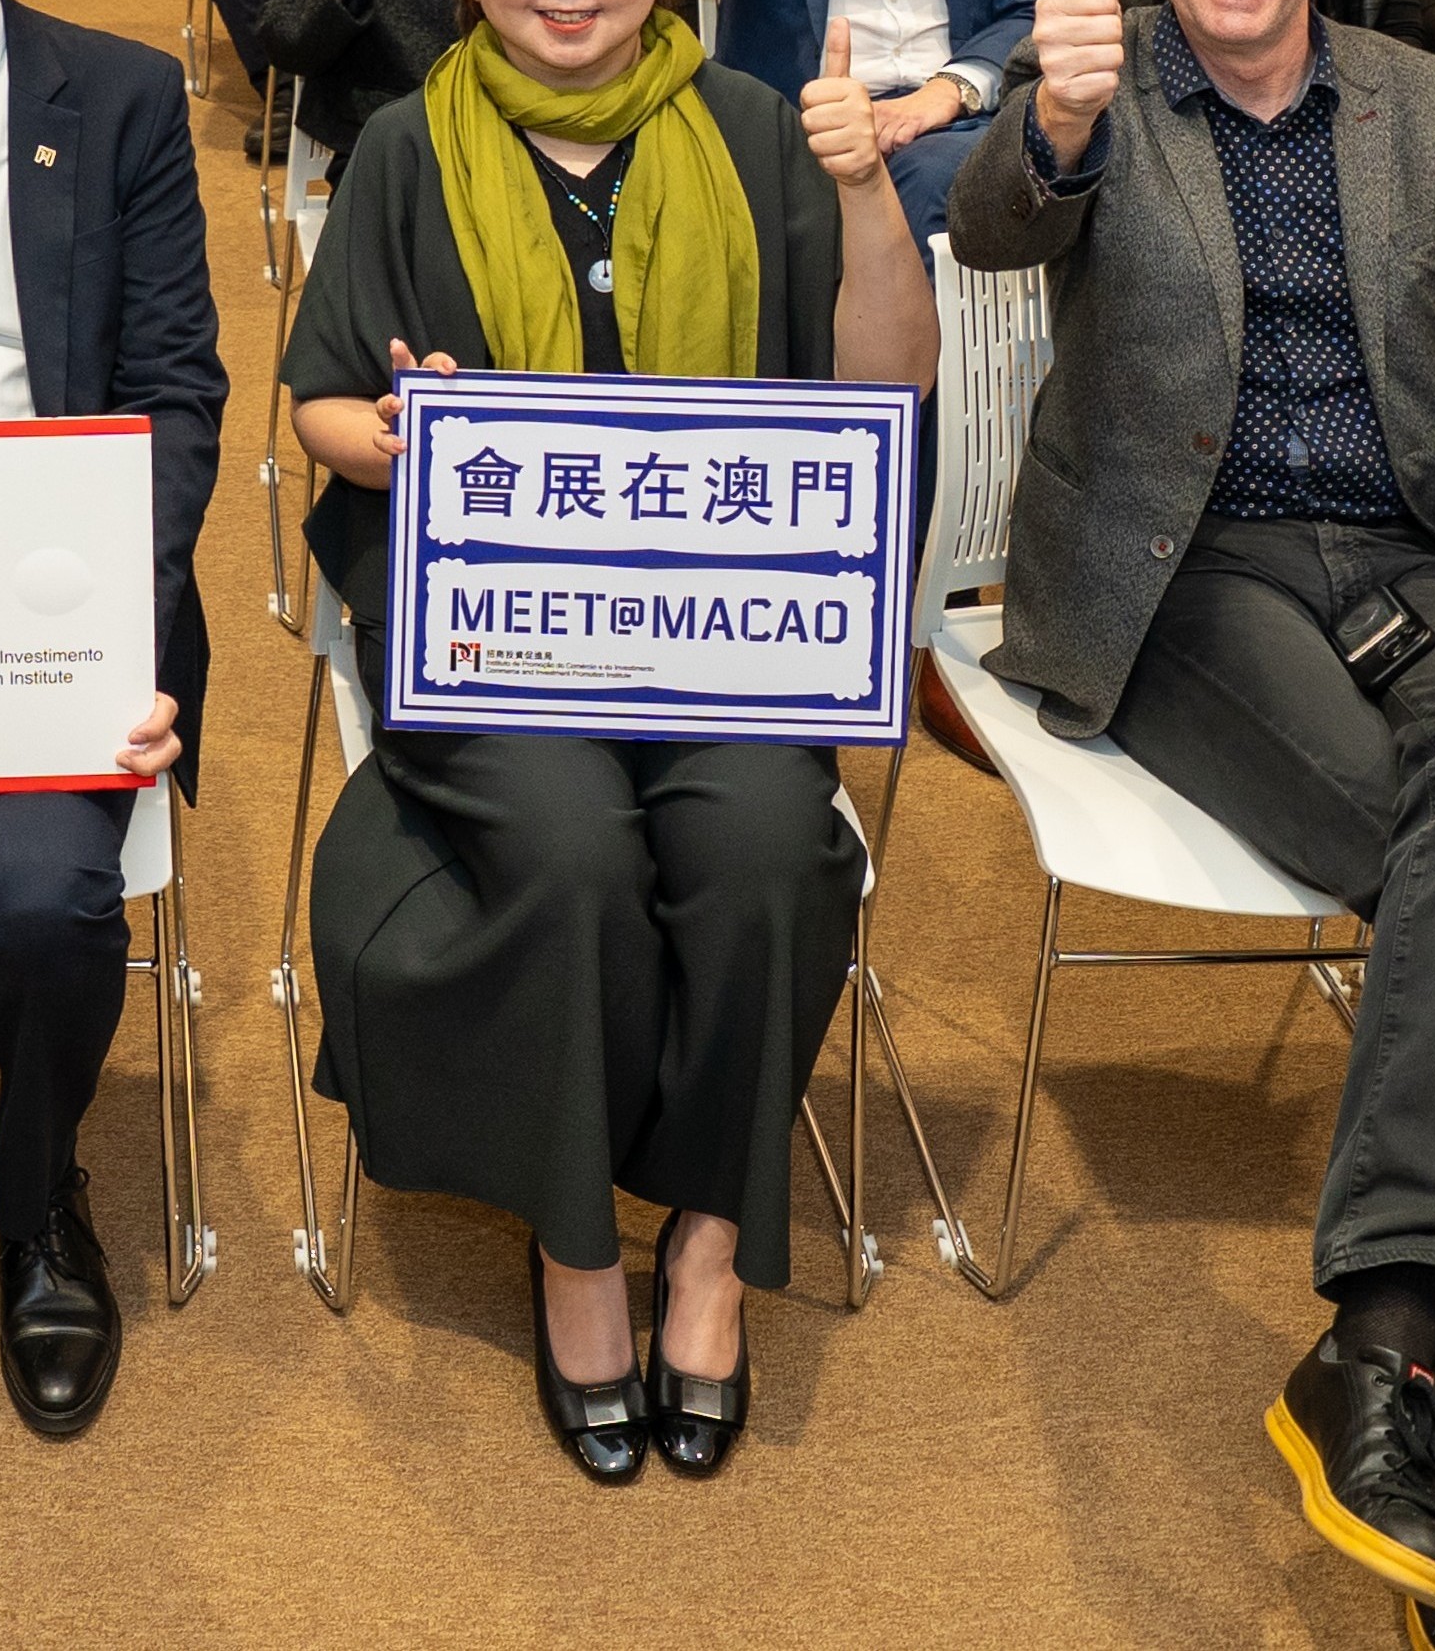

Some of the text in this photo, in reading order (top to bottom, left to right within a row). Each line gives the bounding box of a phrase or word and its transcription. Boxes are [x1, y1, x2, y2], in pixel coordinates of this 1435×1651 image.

[453, 445, 854, 529] 會展在澳門
[450, 587, 848, 645] MEET@MACAO
[0, 649, 103, 664] Investimento
[10, 670, 73, 685] Institute
